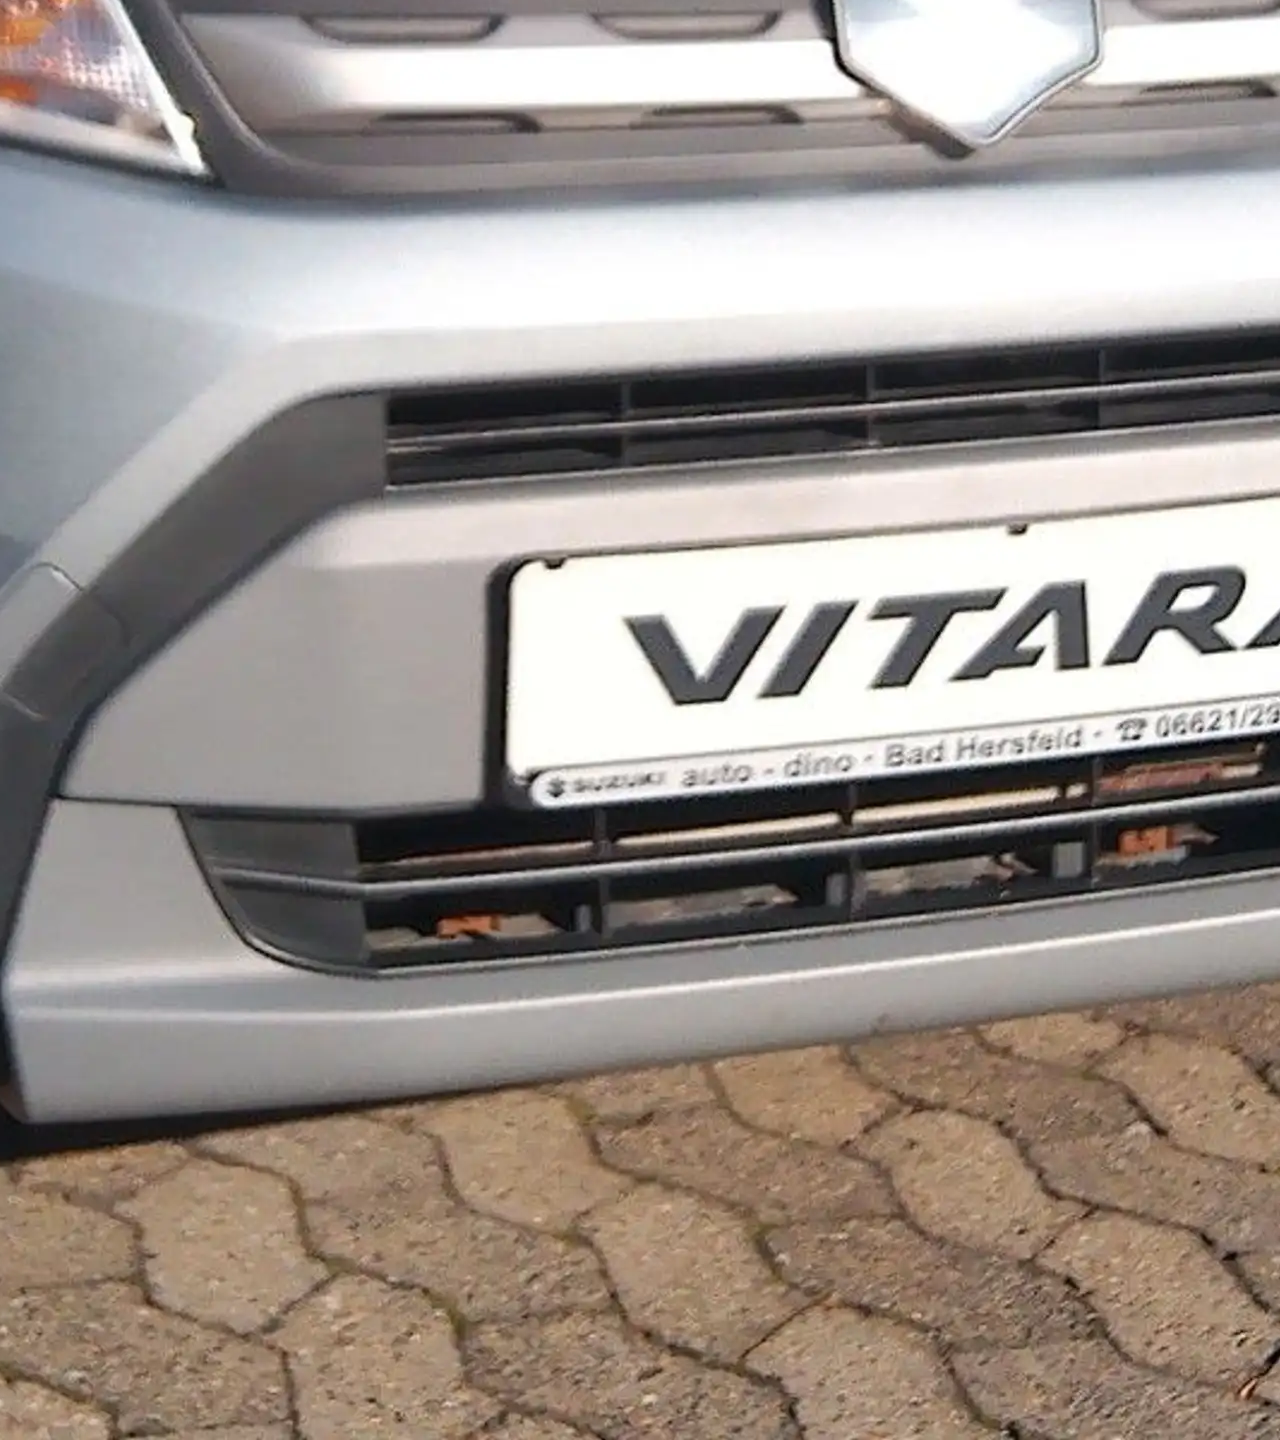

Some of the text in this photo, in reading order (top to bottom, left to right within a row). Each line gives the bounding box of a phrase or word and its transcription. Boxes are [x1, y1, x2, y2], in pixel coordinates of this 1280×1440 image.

[682, 761, 754, 788] auto
[783, 751, 858, 778] dino
[884, 741, 944, 767] Bad
[956, 726, 1083, 759] Hersfeld
